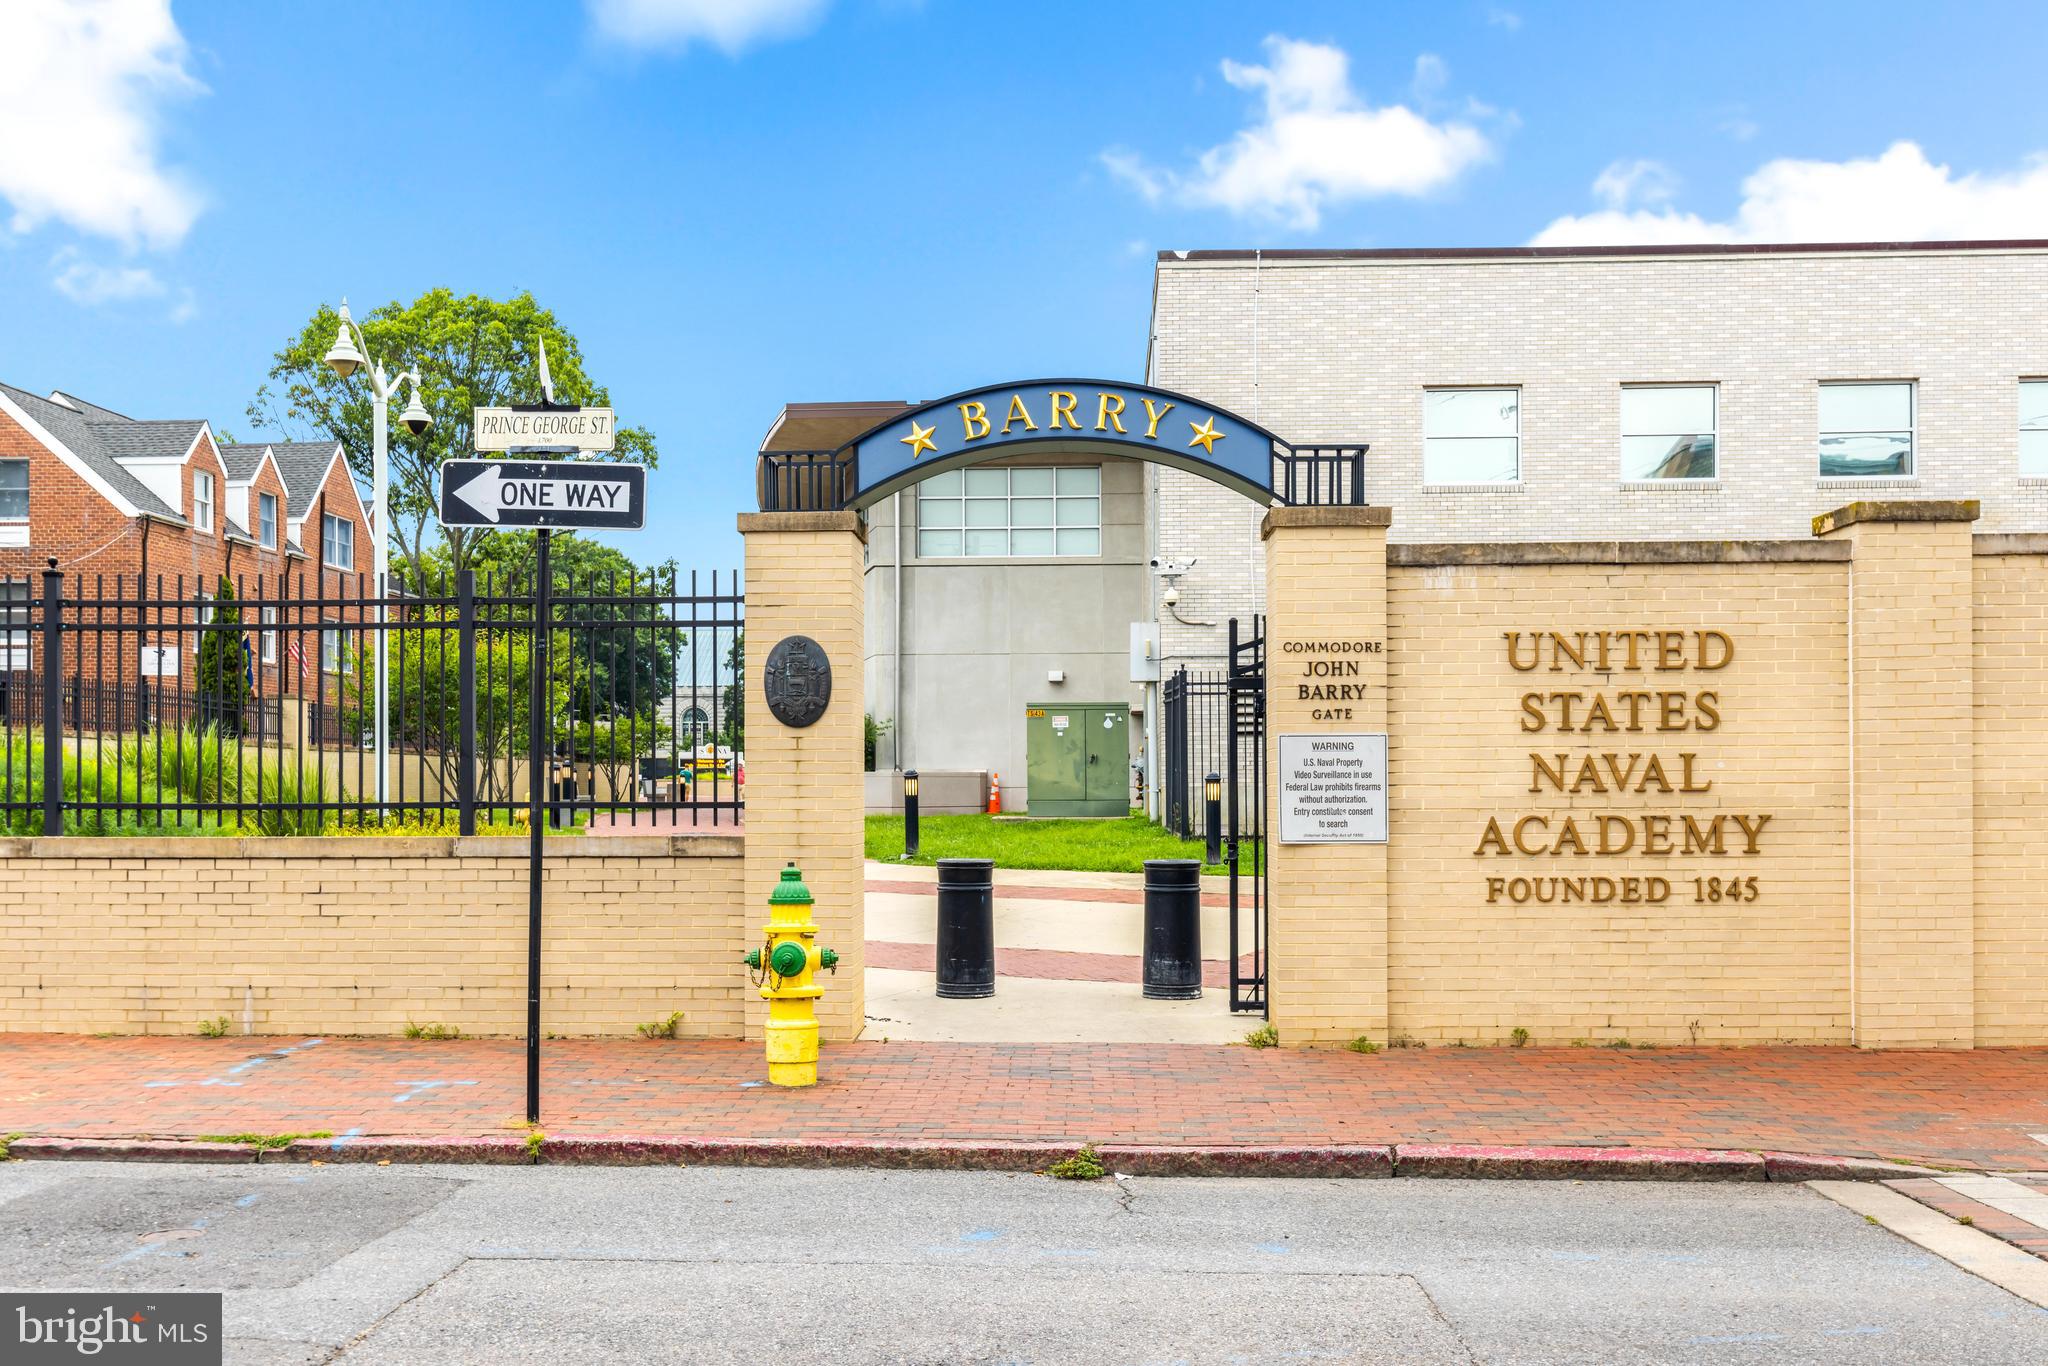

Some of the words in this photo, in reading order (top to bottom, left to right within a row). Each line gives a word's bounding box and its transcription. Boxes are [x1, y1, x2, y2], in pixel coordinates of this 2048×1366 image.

[957, 391, 1176, 442] BARRY
[482, 416, 530, 434] PRINCE
[533, 416, 586, 434] GEORGE
[590, 416, 609, 434] ST.
[501, 482, 554, 506] ONE
[565, 483, 622, 508] WAY
[1283, 642, 1382, 653] COMMODORE
[1503, 630, 1735, 671] UNITED
[1303, 661, 1359, 677] JOHN
[1298, 684, 1367, 700] BARRY
[1312, 708, 1353, 720] GATE
[1520, 691, 1721, 732] STATES
[1312, 742, 1354, 751] WARNING
[1303, 758, 1315, 767] U.S.
[1317, 758, 1335, 767] Naval
[1336, 758, 1363, 768] Property
[1294, 770, 1312, 779] Video
[1313, 770, 1352, 779] Surveillance
[1353, 770, 1360, 779] in
[1528, 752, 1712, 793] NAVAL
[1285, 782, 1309, 791] Federal
[1310, 782, 1324, 791] Law
[1325, 783, 1353, 793] prohibits
[1354, 782, 1381, 791] firearms
[1299, 795, 1323, 804] without
[1324, 795, 1368, 804] authorization.
[1293, 807, 1310, 817] Entry
[1311, 807, 1347, 816] constitutes
[1348, 808, 1374, 816] consent
[1319, 820, 1325, 828] to
[1326, 820, 1349, 828] search
[1473, 814, 1773, 856] ACADEMY
[1485, 876, 1672, 904] FOUNDED
[1694, 876, 1760, 904] 1845
